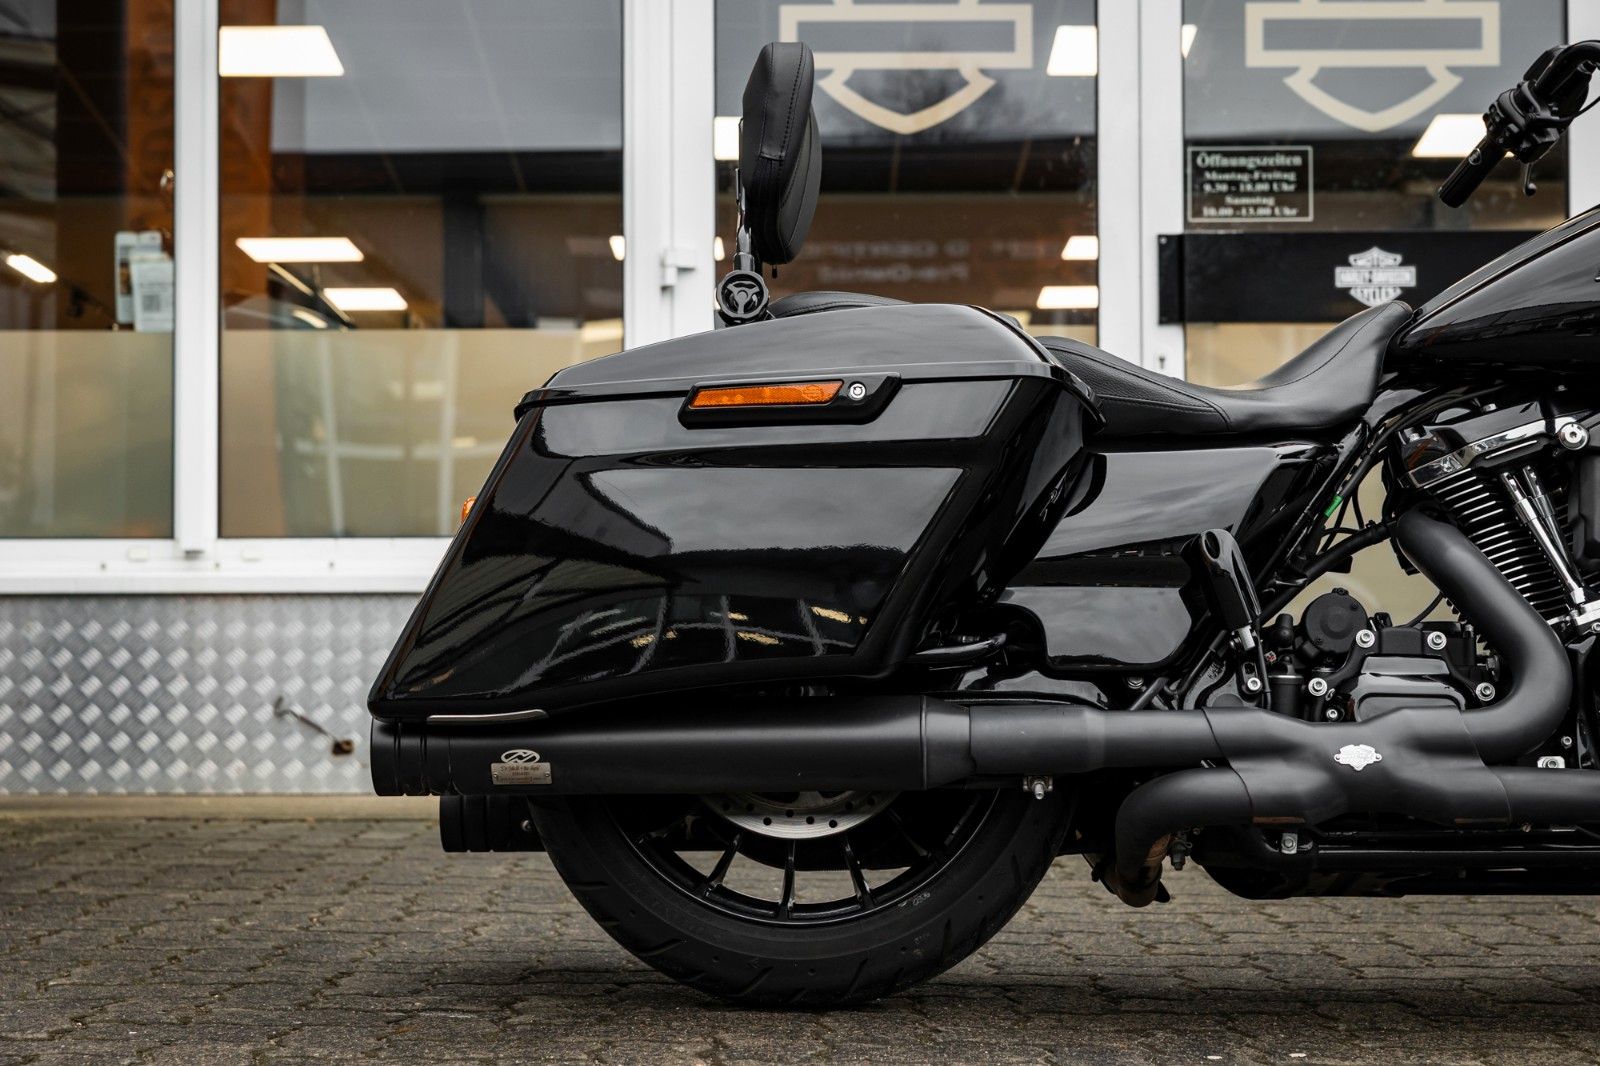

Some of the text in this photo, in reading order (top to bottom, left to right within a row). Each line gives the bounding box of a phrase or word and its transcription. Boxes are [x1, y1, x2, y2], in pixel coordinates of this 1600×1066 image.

[1197, 152, 1302, 170] Öffnungszeiten
[1272, 181, 1296, 192] Uhr
[1225, 194, 1275, 206] Samstag
[1274, 206, 1298, 217] Uhr
